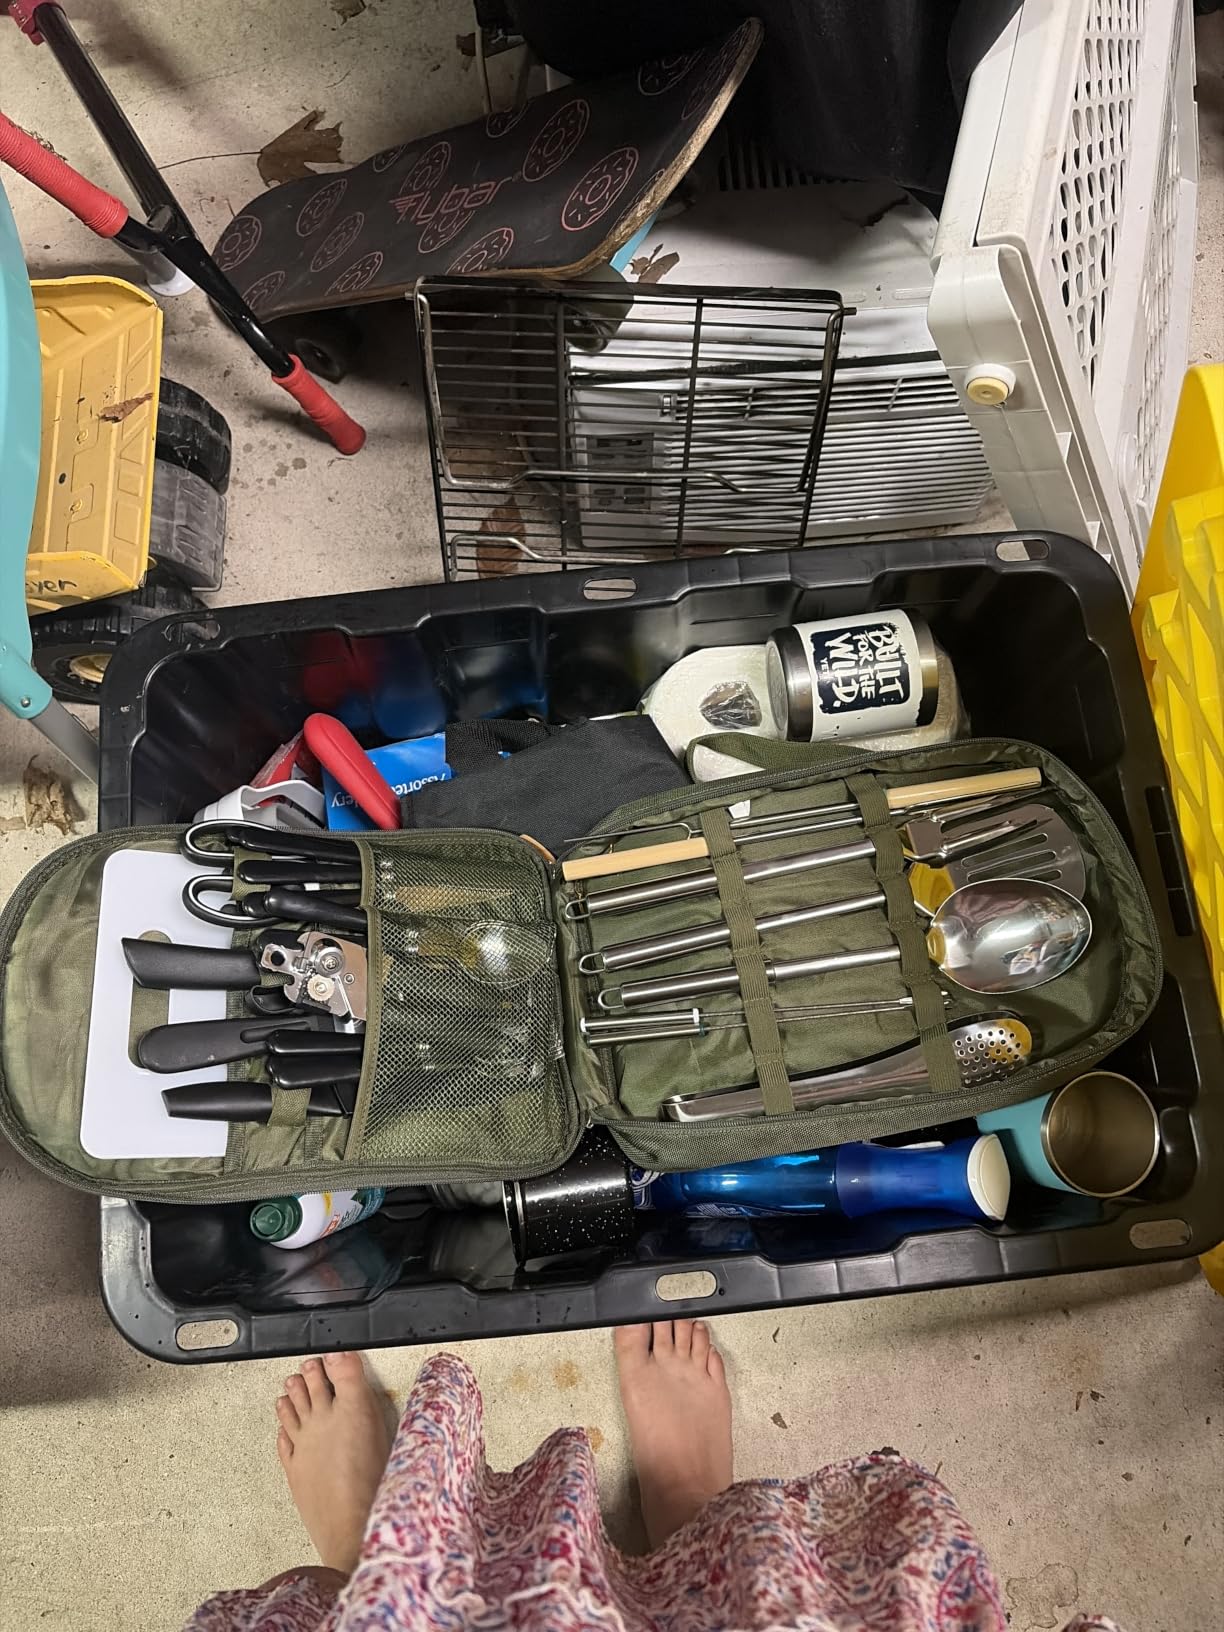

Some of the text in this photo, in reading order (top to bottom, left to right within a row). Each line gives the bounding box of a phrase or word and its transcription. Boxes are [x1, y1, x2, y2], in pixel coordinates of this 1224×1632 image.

[389, 178, 511, 225] Flybar
[852, 630, 875, 699] FOR THE
[865, 625, 904, 699] BUILT
